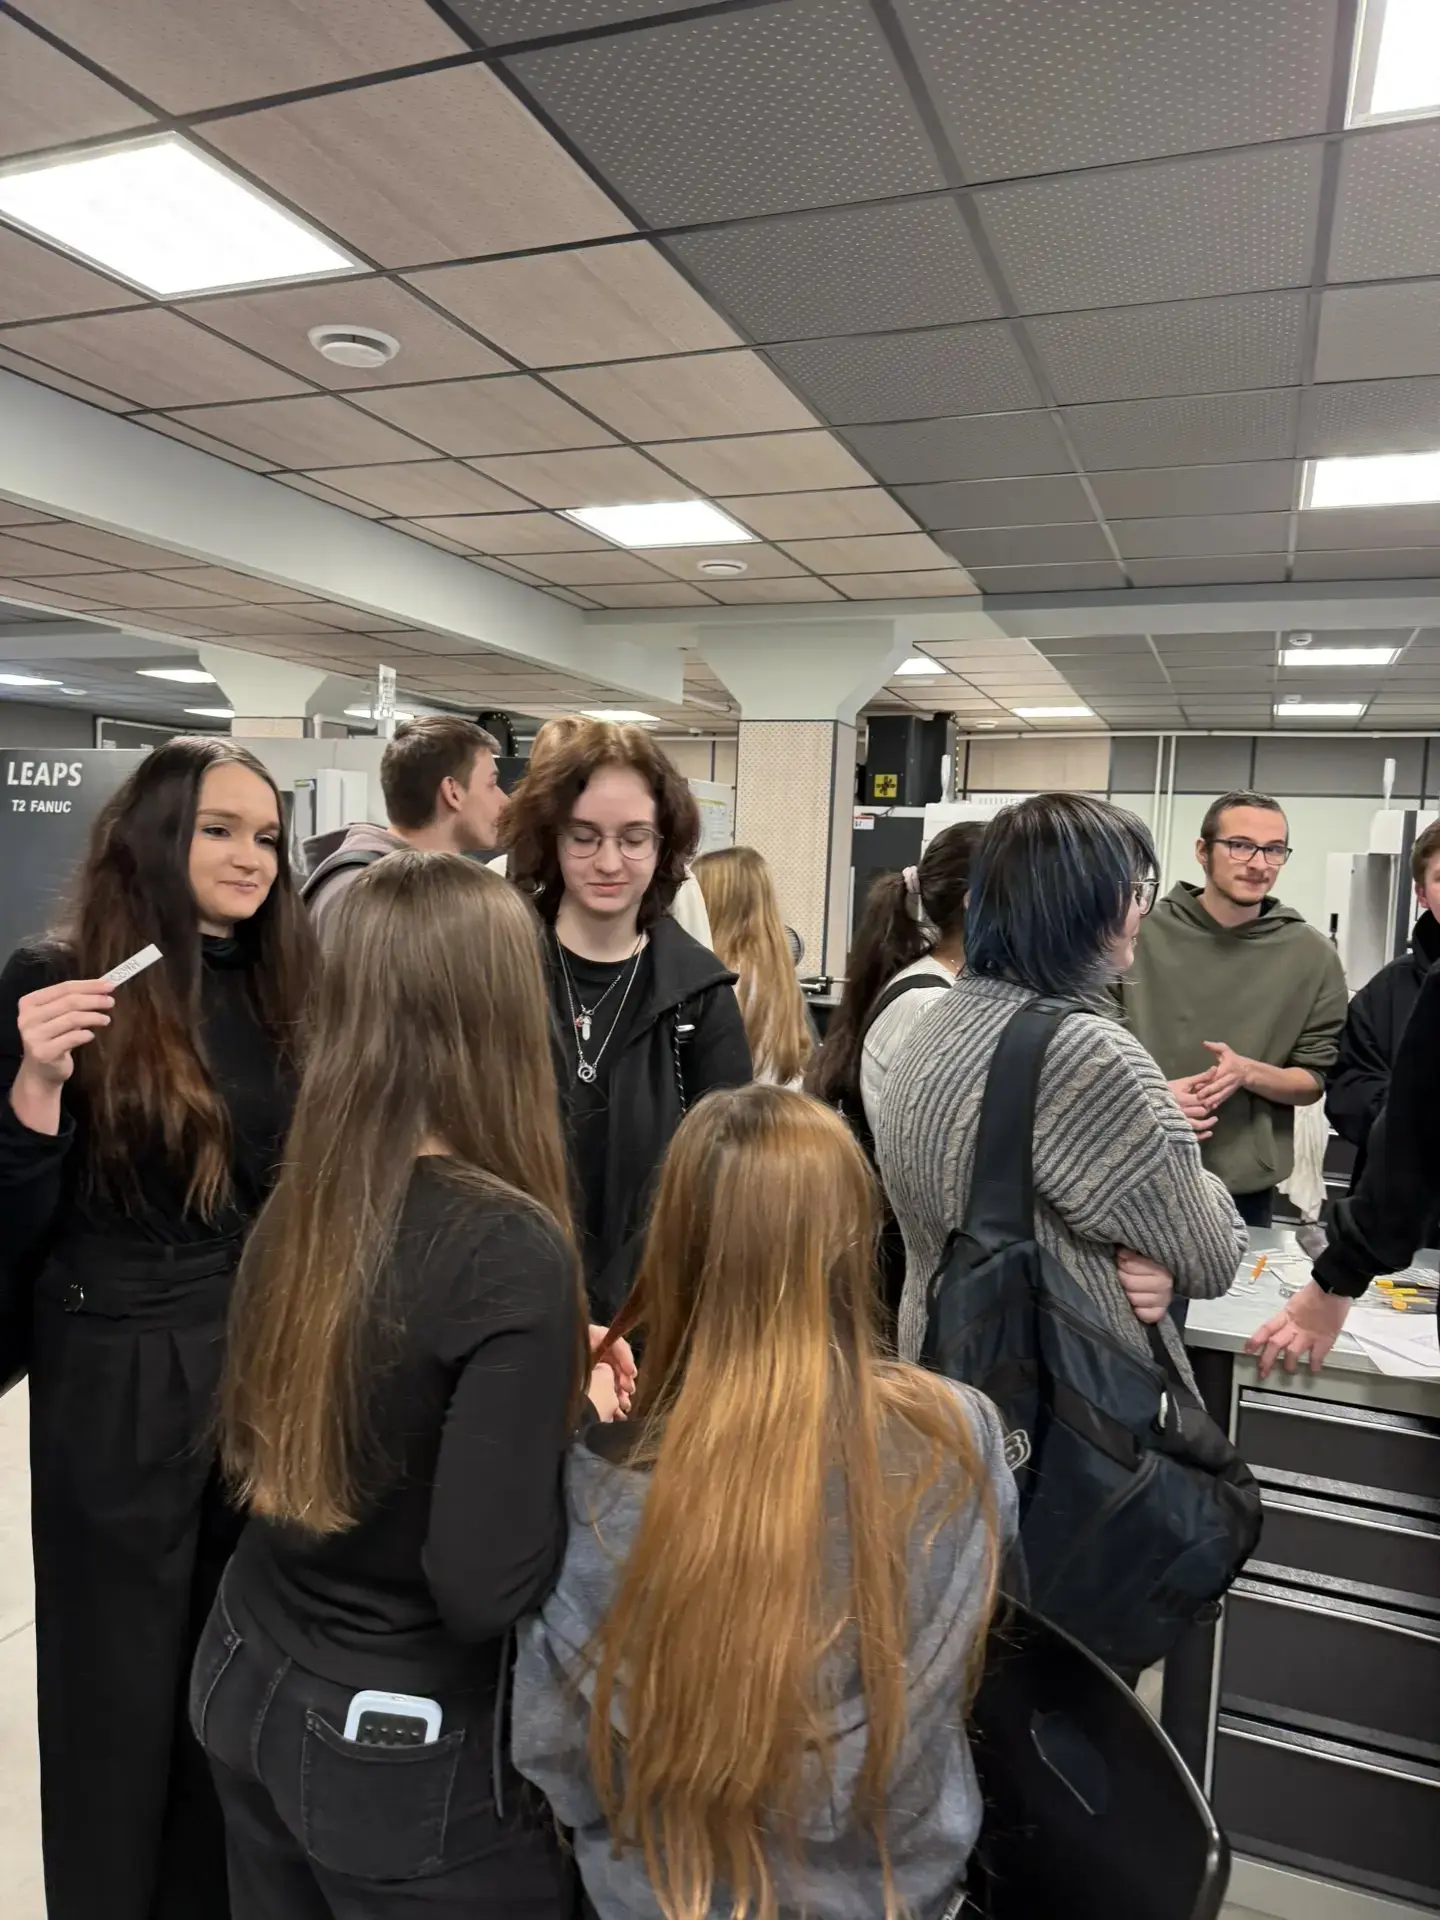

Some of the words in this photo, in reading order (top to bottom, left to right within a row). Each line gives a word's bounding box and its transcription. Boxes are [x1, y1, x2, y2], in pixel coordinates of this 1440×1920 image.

[7, 761, 83, 787] LEAPS
[11, 799, 26, 812] T2
[30, 800, 72, 813] FANUC
